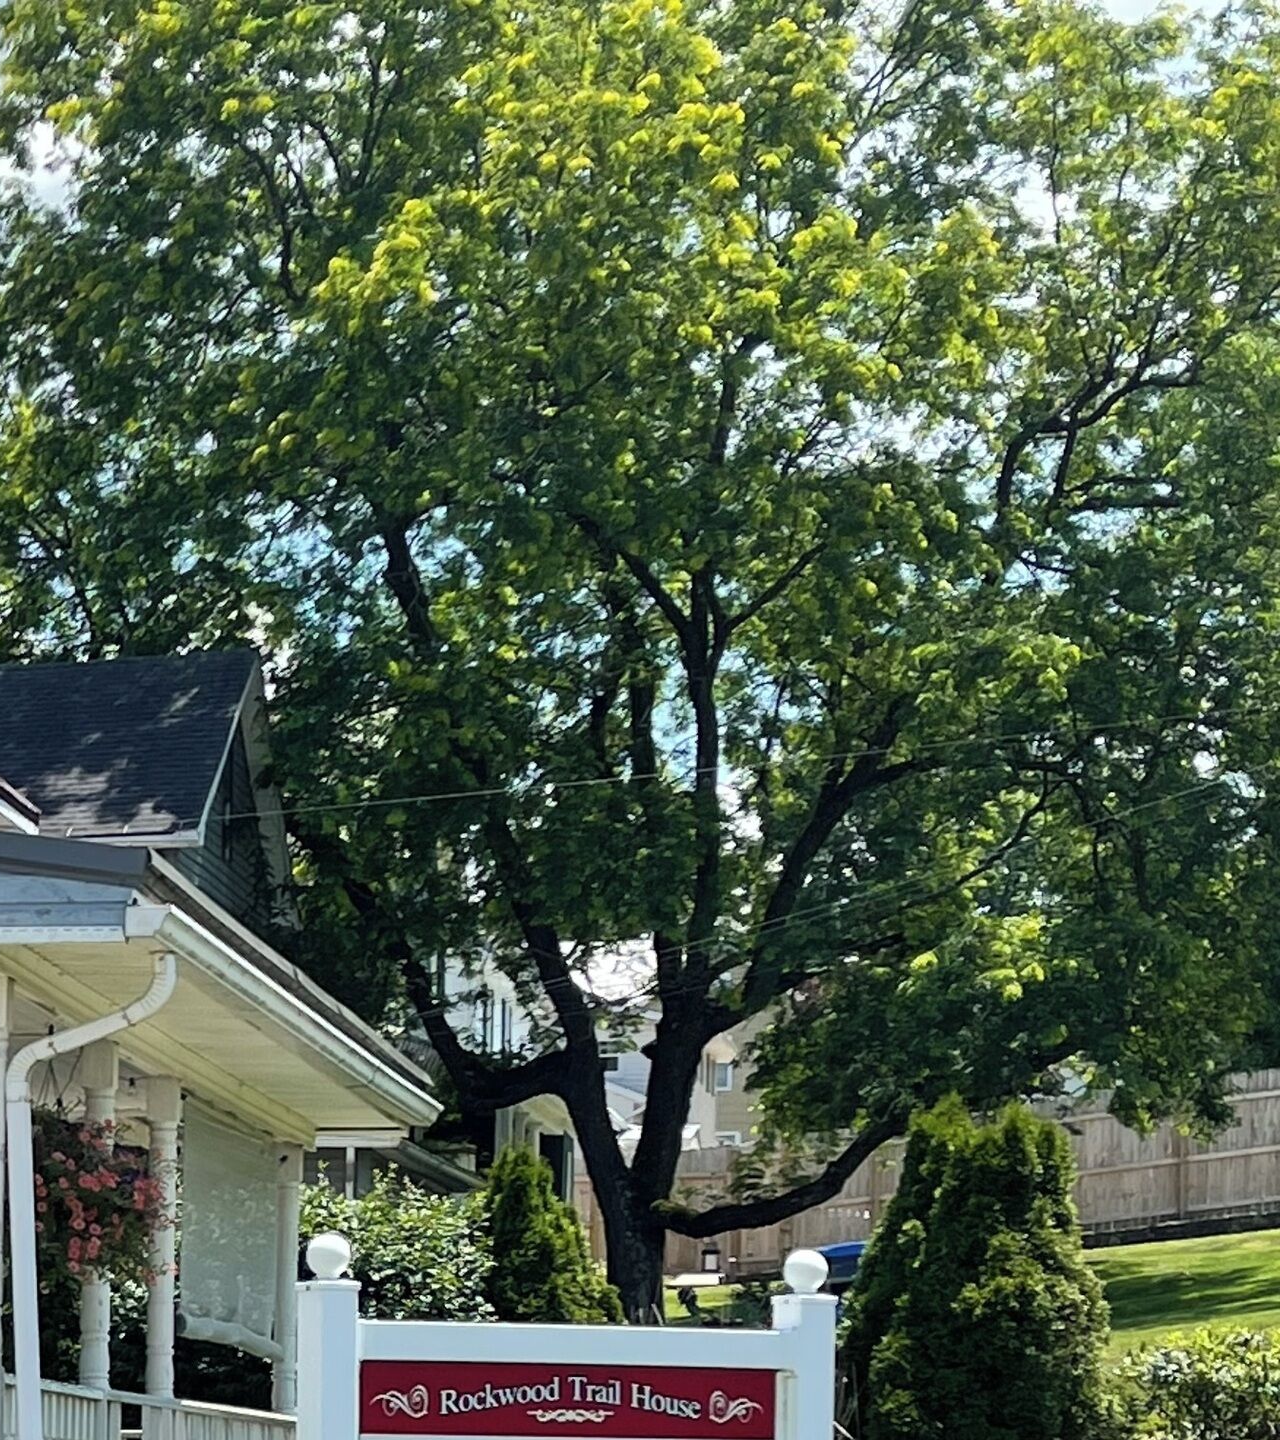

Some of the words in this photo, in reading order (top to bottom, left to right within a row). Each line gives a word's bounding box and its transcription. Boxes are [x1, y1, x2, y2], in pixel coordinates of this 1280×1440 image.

[440, 1377, 559, 1414] Rockwood
[568, 1377, 622, 1405] Trail
[630, 1387, 702, 1419] House
